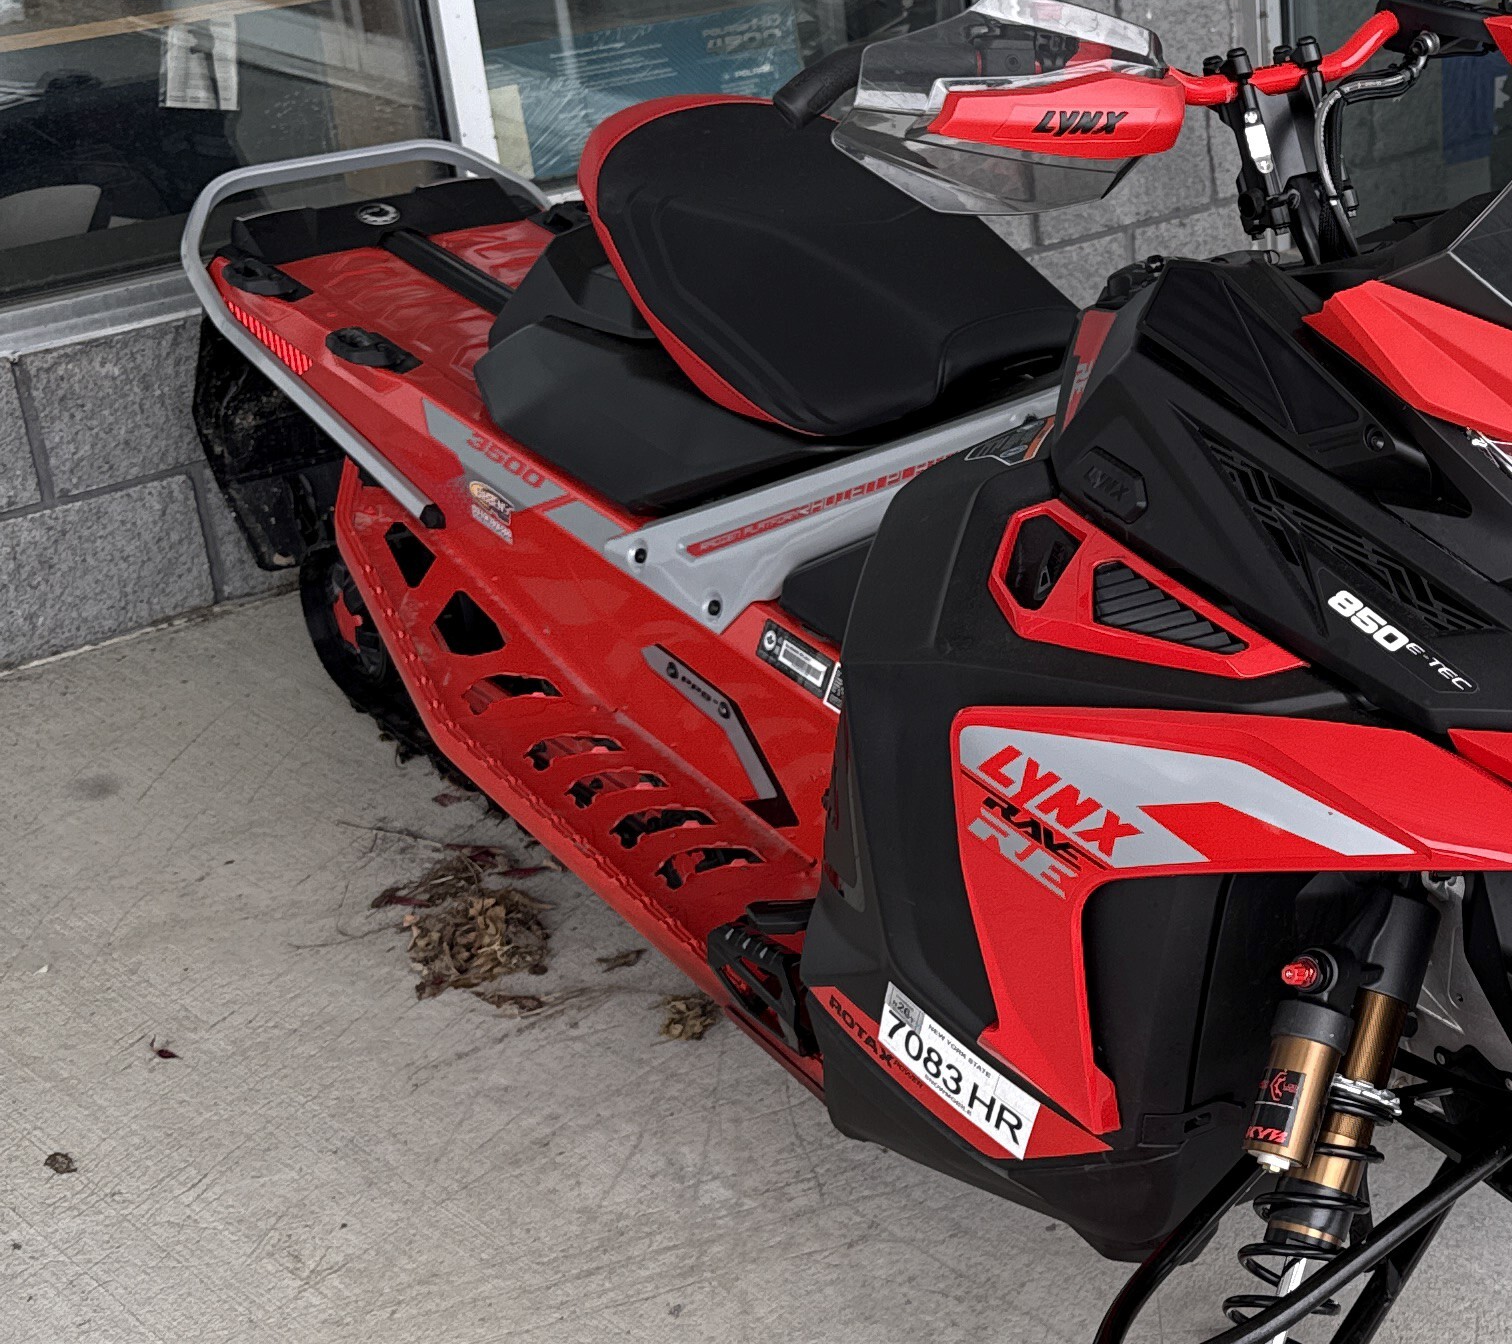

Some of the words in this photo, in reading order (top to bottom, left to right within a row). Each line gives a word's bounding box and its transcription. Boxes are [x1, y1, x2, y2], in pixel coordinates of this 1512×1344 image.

[1031, 110, 1129, 138] LYNX
[1083, 464, 1131, 502] LYNX
[1327, 589, 1410, 652] 850
[1405, 642, 1473, 691] E-TEC
[976, 744, 1144, 858] LYNX
[981, 796, 1083, 873] RAVE
[828, 993, 893, 1068] ROTAX
[967, 1056, 992, 1080] STATE
[887, 1008, 963, 1096] 7083
[967, 1081, 1025, 1146] HR
